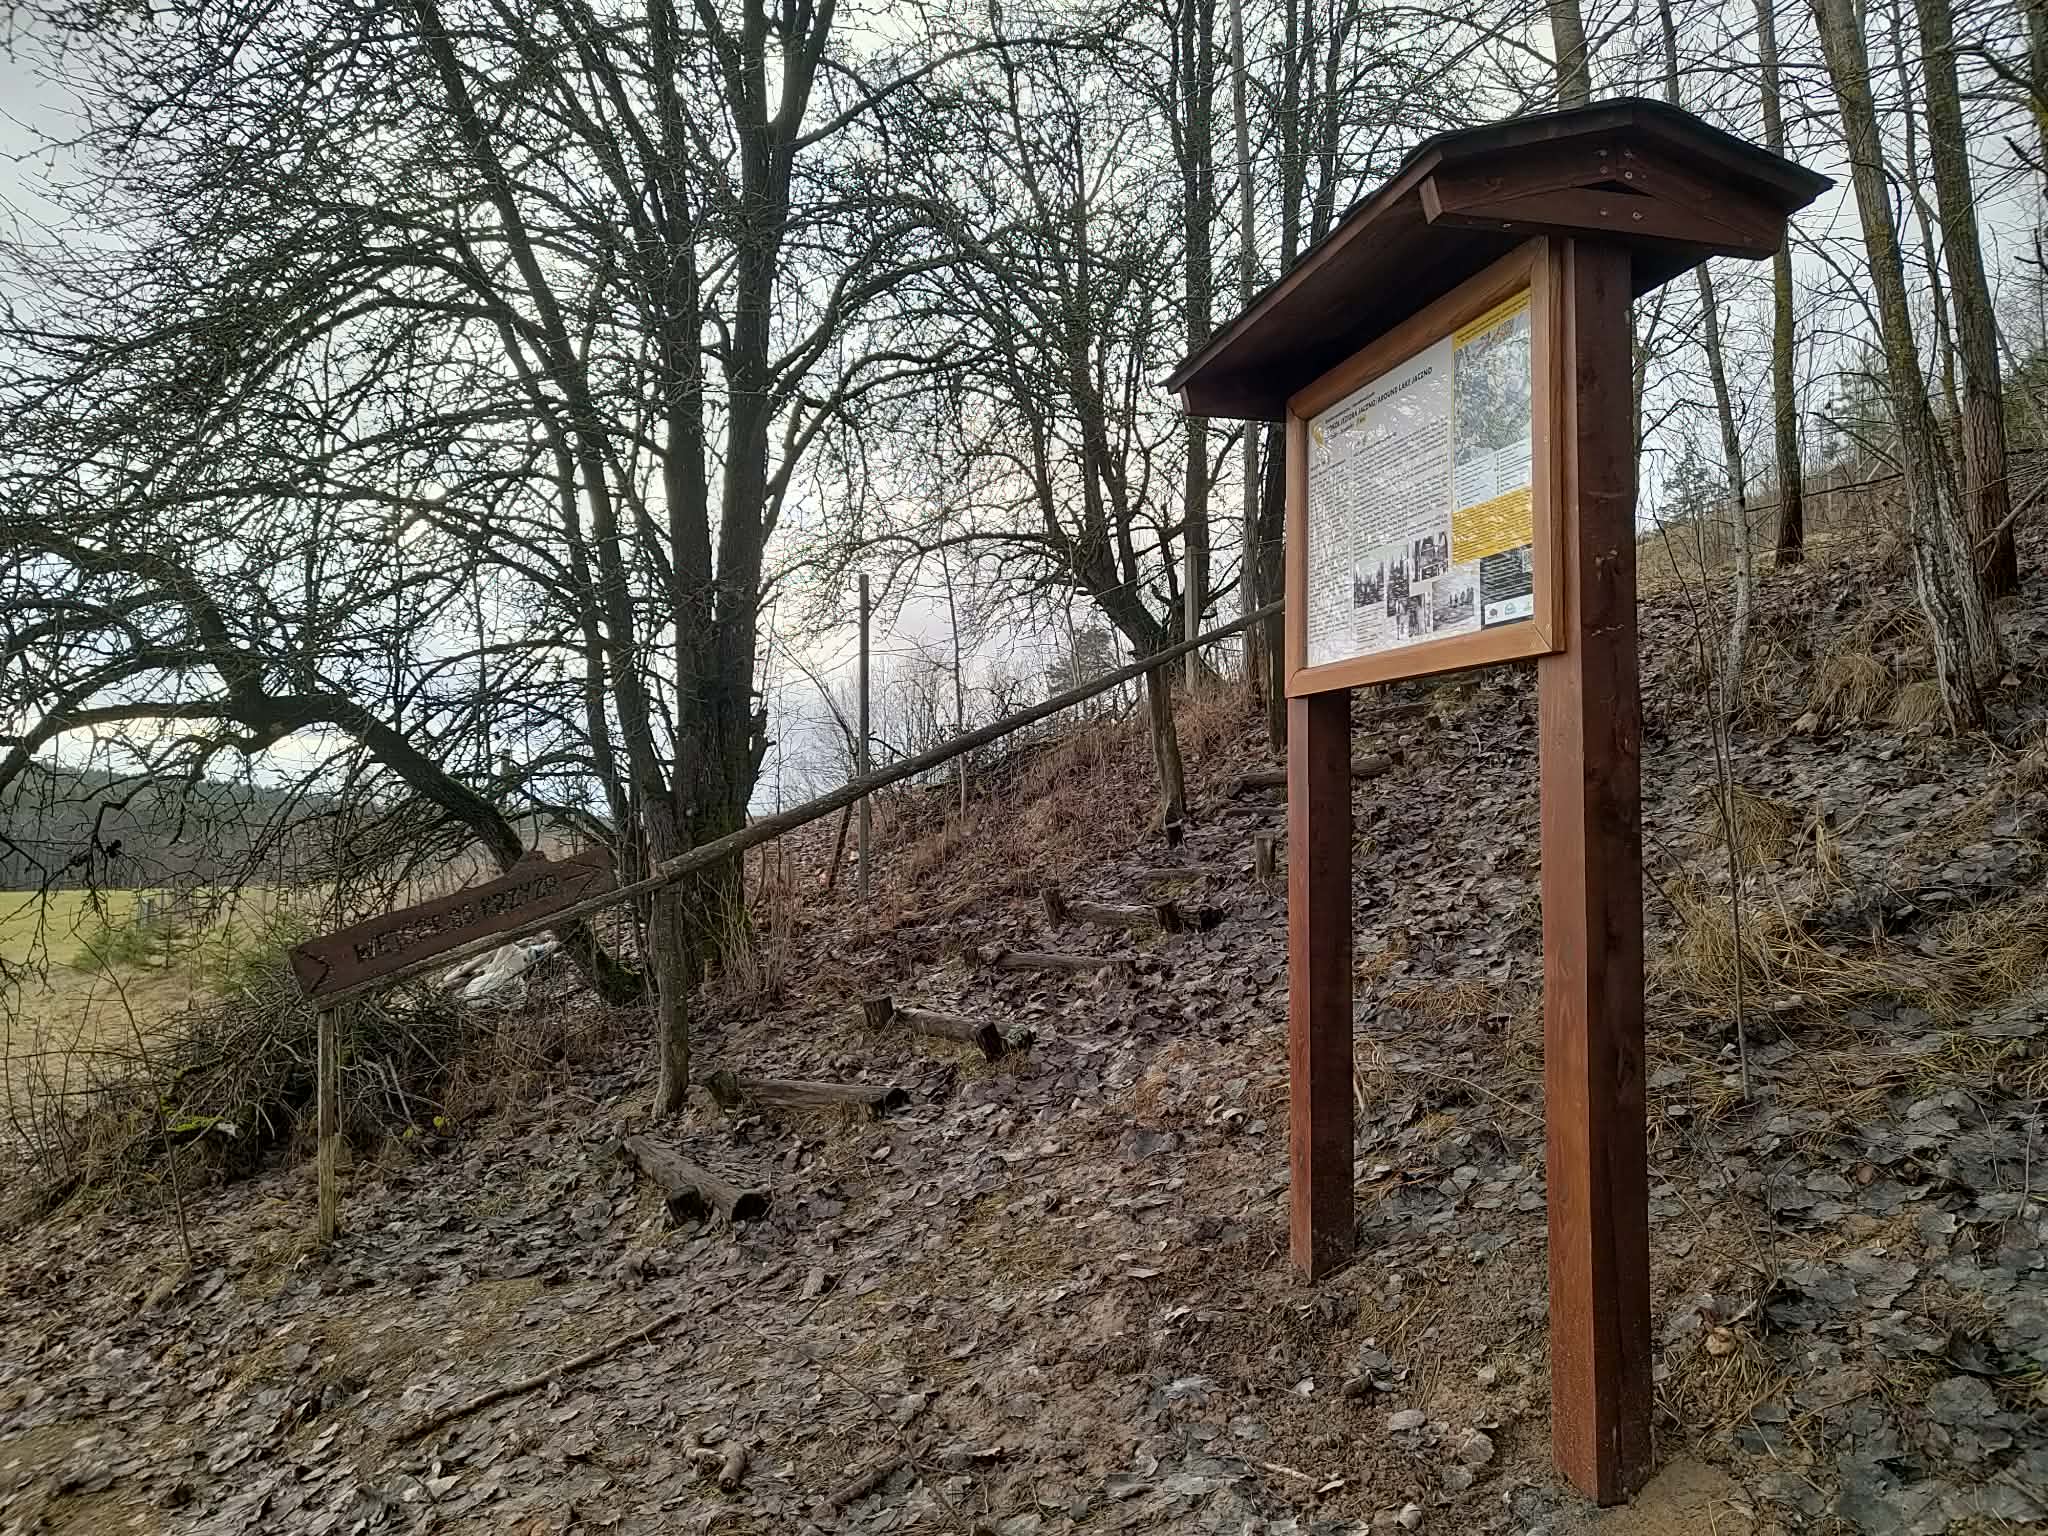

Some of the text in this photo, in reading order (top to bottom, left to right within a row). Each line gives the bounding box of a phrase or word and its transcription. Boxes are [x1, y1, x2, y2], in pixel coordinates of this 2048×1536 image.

[1377, 386, 1398, 404] AROUND
[1398, 380, 1411, 392] LAKE
[1411, 366, 1433, 384] JACZNO
